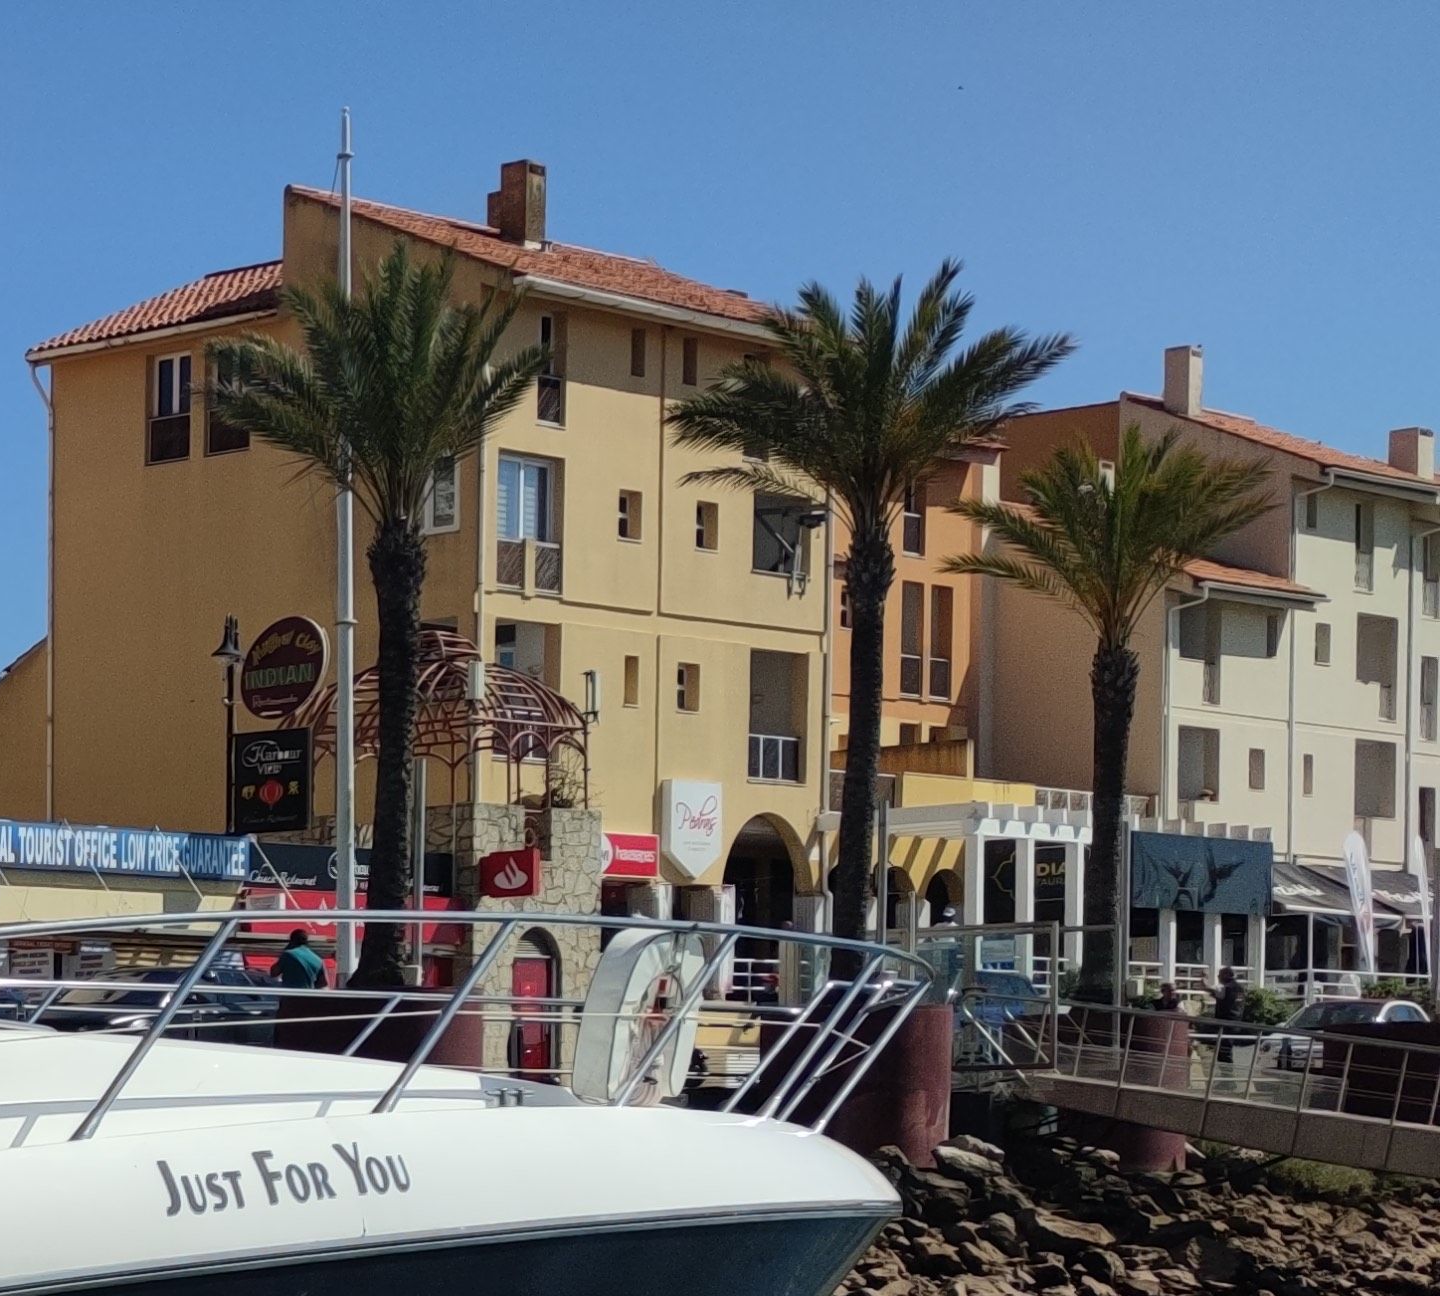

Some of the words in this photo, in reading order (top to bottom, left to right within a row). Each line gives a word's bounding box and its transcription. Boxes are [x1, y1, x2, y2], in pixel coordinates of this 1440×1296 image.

[245, 662, 315, 690] INDIAN
[17, 826, 72, 866] TOURIST
[74, 829, 118, 869] OFFICE
[121, 832, 147, 870] LOW
[148, 834, 180, 872] PRICE
[181, 836, 246, 876] GUARANTEE
